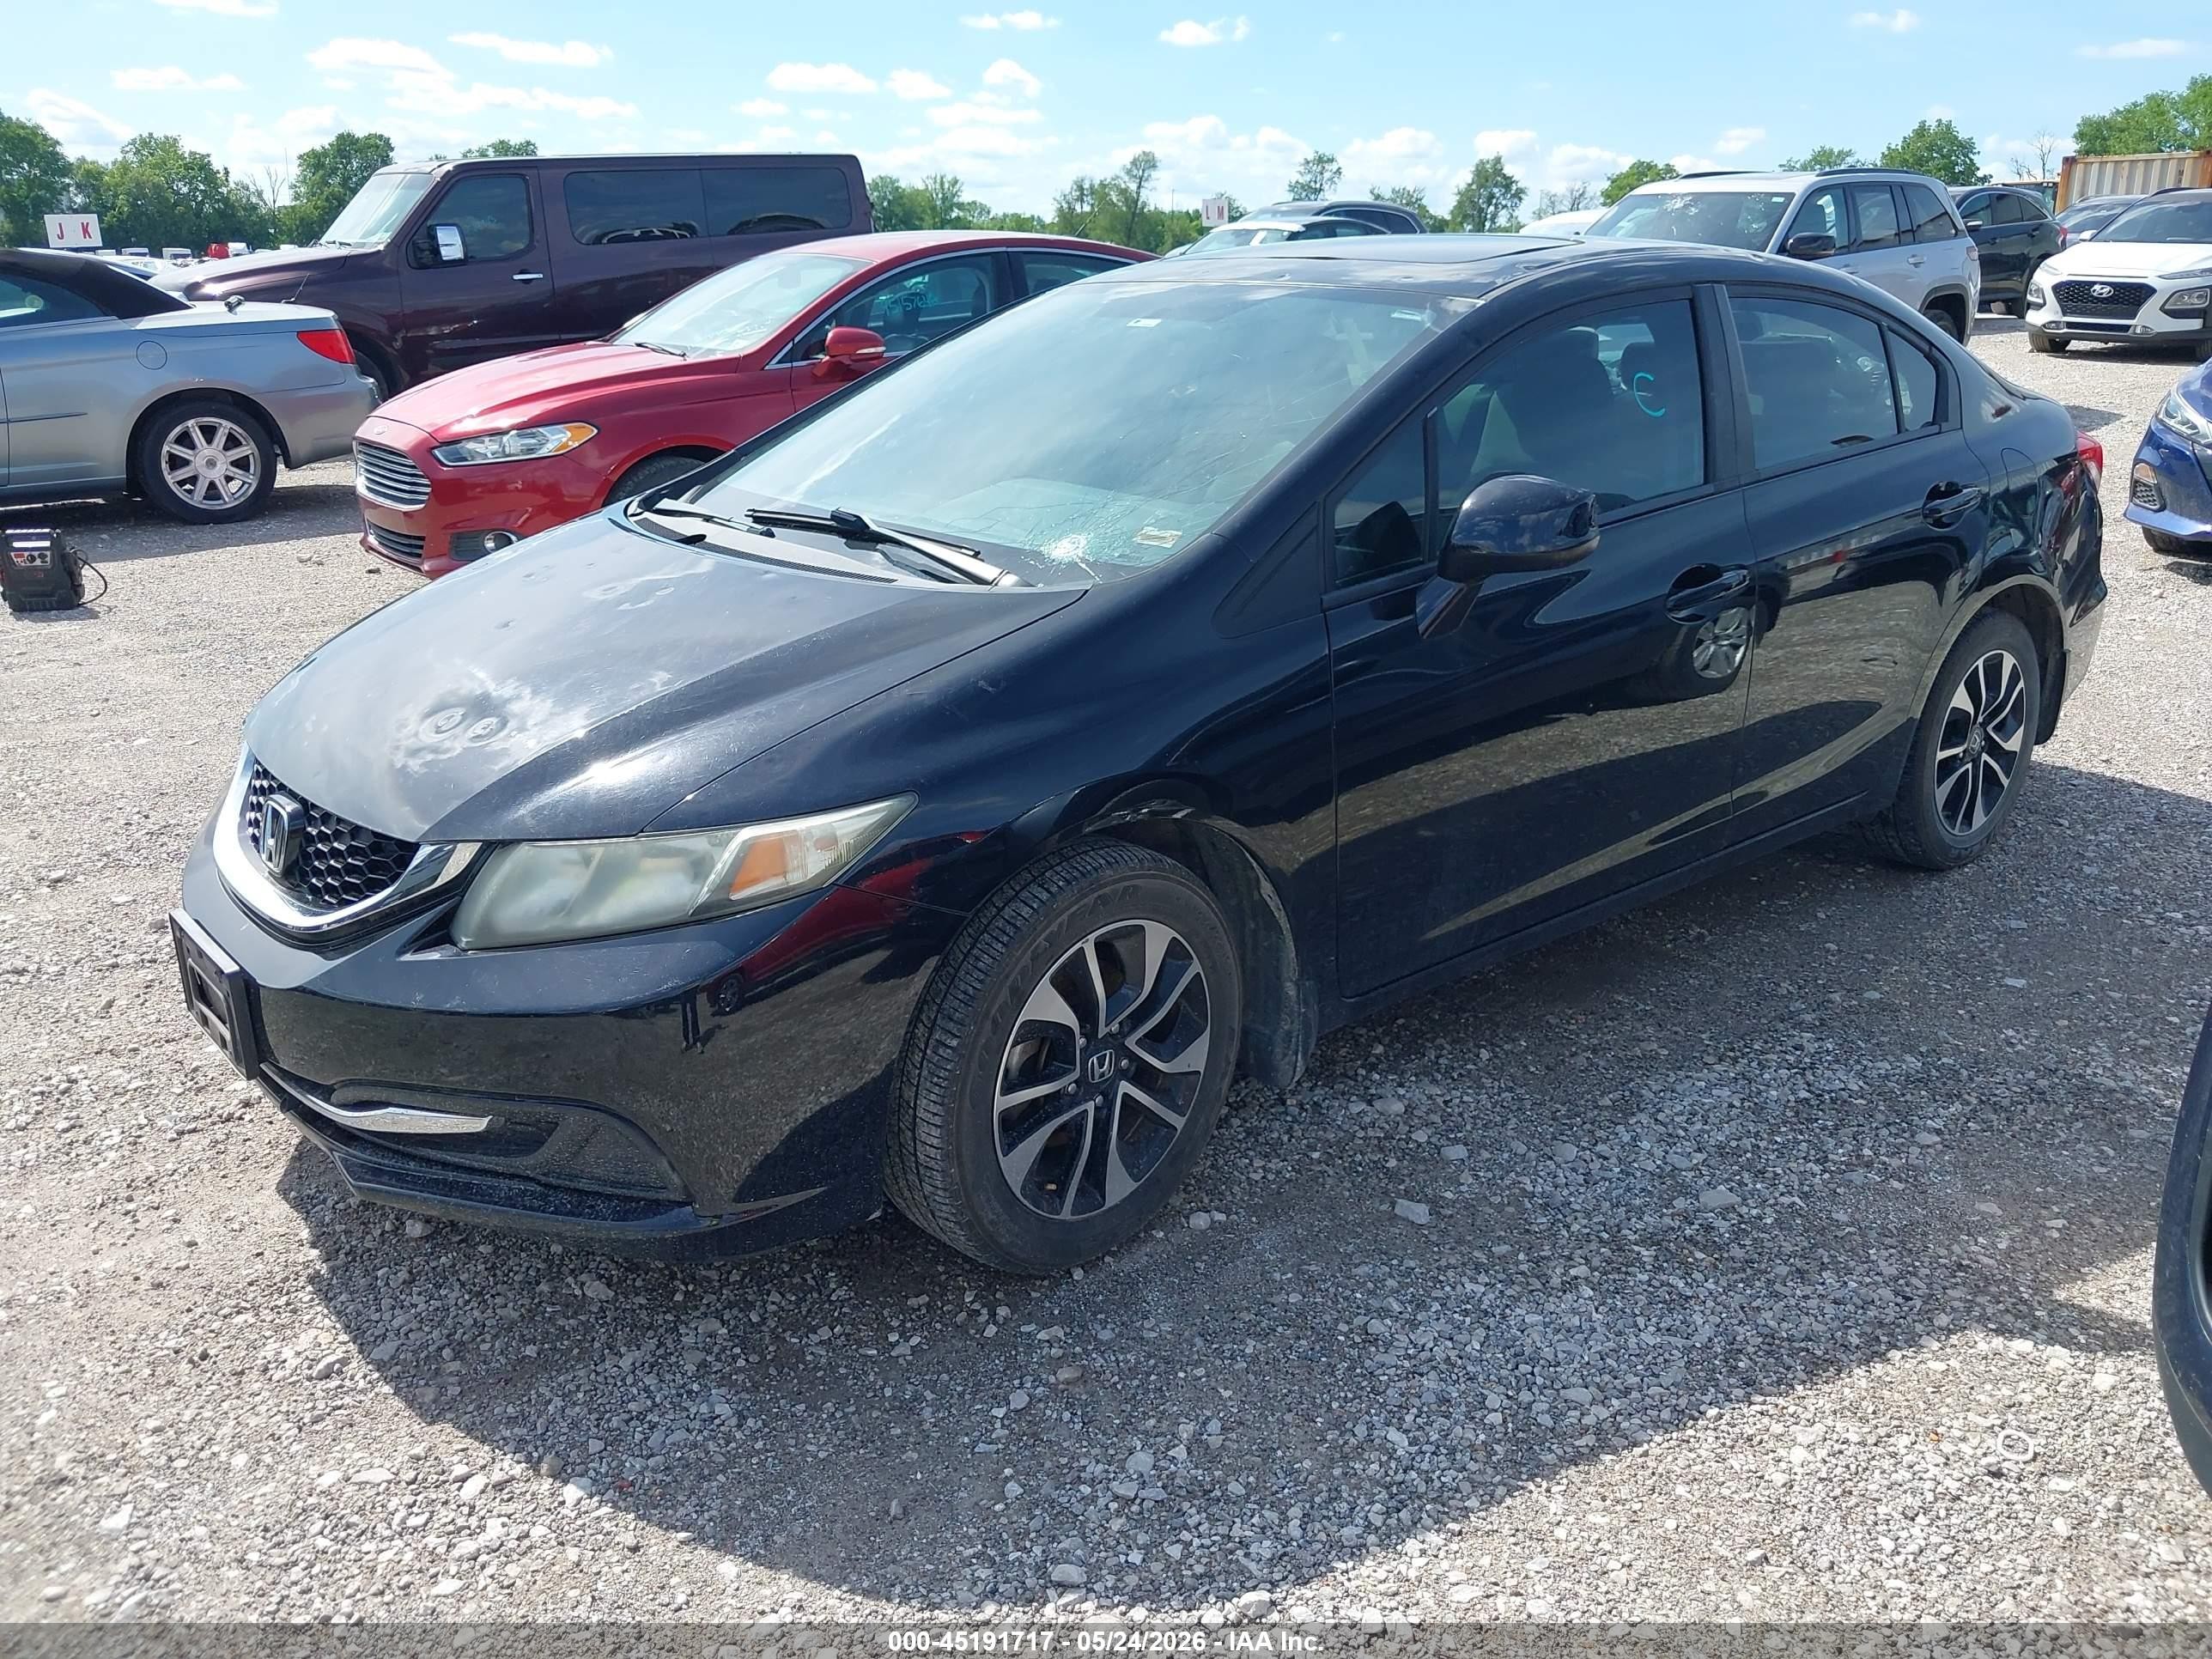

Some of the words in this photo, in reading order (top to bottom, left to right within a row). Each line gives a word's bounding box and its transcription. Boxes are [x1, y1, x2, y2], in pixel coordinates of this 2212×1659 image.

[1217, 205, 1224, 221] M
[57, 222, 64, 240] J
[81, 222, 92, 240] K
